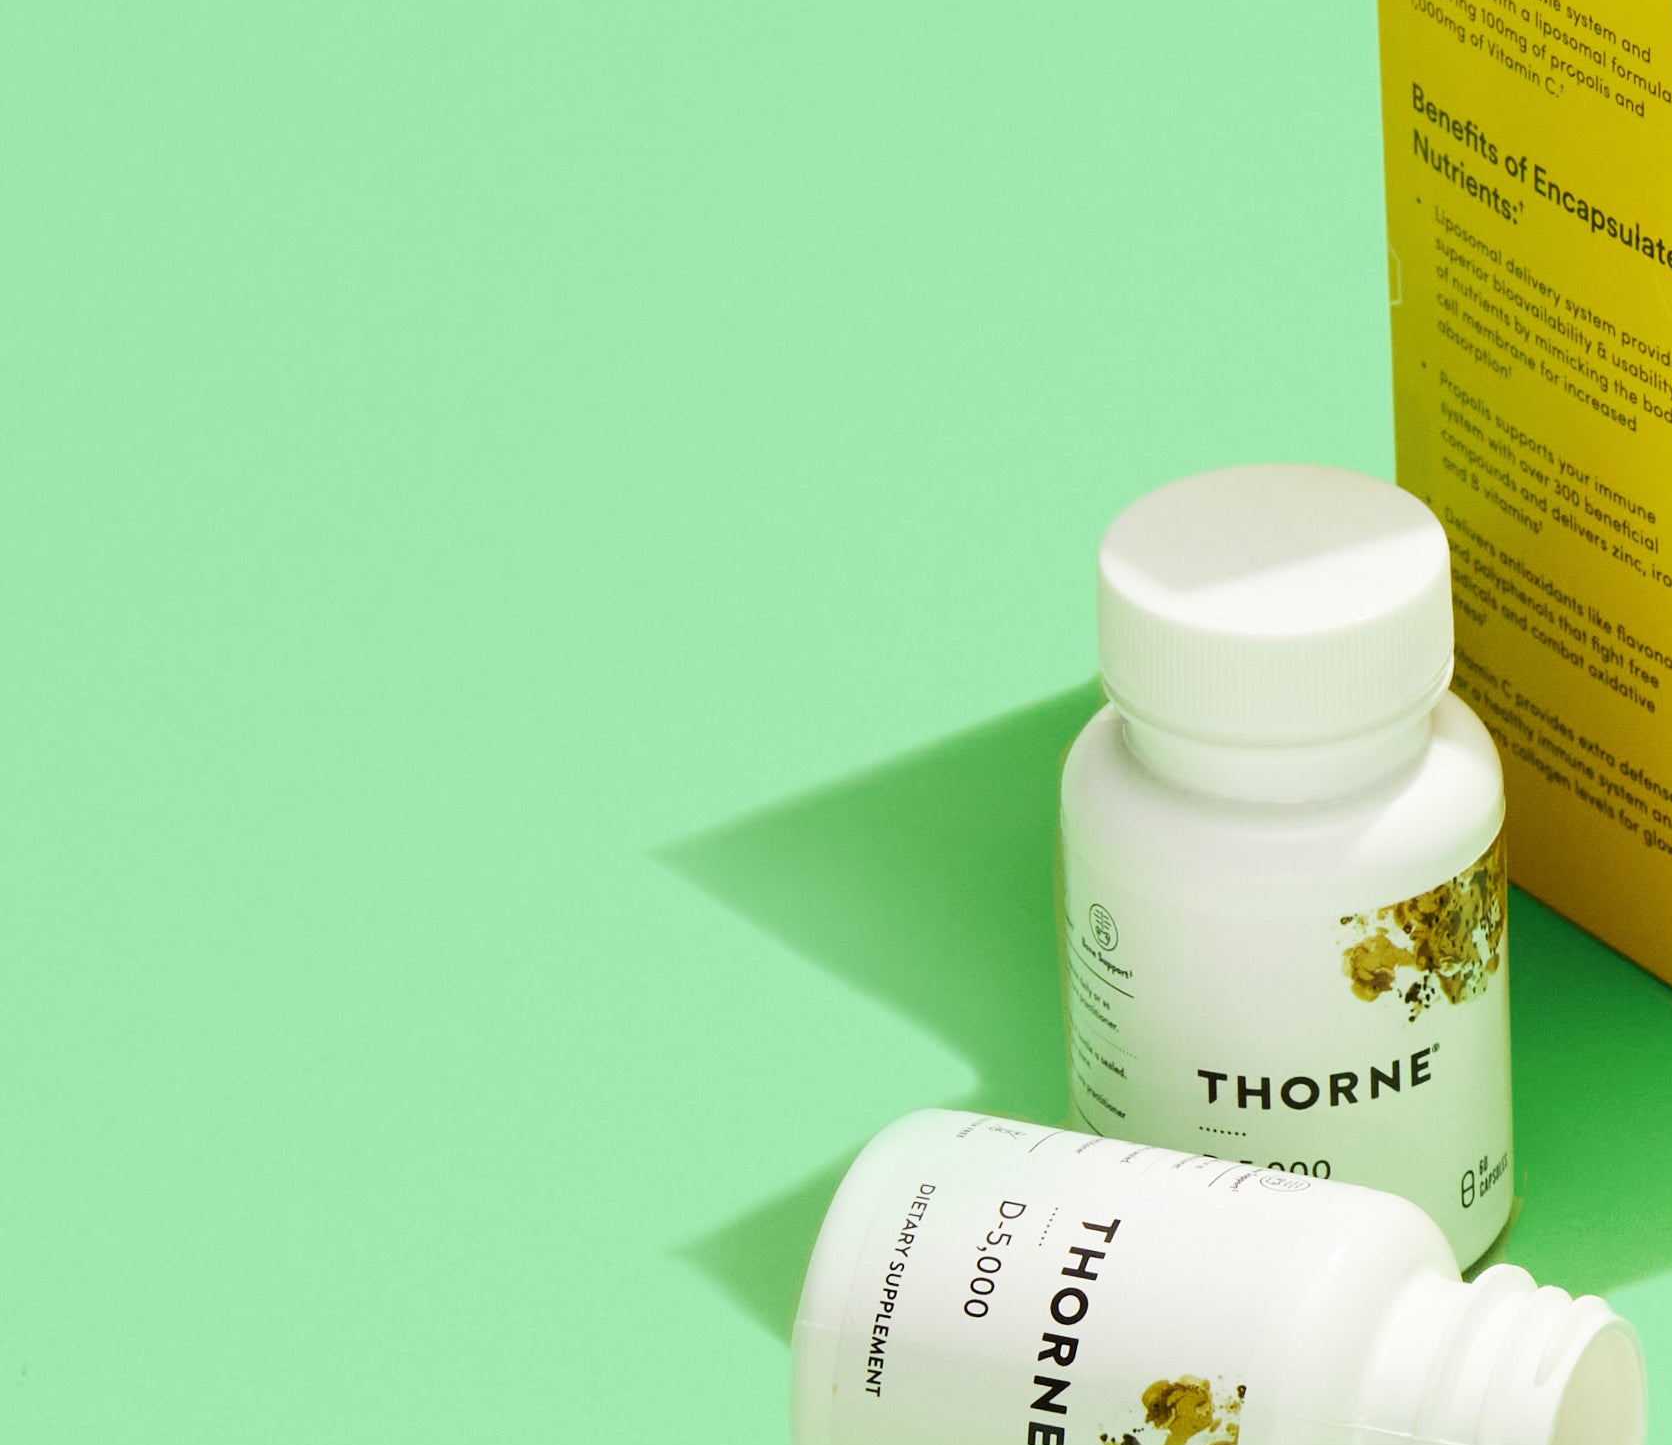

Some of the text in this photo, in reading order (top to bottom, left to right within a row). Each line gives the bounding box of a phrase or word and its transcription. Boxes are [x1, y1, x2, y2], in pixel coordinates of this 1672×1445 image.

[1470, 30, 1540, 86] of Vitamin
[1481, 8, 1527, 53] 100mg
[1532, 43, 1546, 59] of
[1615, 90, 1644, 118] and
[1521, 8, 1530, 22] a
[1535, 11, 1606, 66] liposomal
[1611, 58, 1672, 104] formula
[1566, 3, 1616, 44] system
[1621, 37, 1651, 63] and
[1412, 82, 1498, 165] Benefits
[1504, 154, 1527, 183] of
[1435, 208, 1502, 266] Liposomal
[1506, 258, 1561, 308] delivery
[1565, 297, 1616, 337] system
[1435, 237, 1489, 282] superior
[1597, 342, 1607, 359] &
[1436, 265, 1638, 406] of by mimicking the
[1540, 360, 1637, 432] for increased
[1495, 415, 1656, 525] supports your immune
[1520, 460, 1659, 554] over 300 beneficial
[1521, 483, 1608, 553] and delivers
[1588, 606, 1612, 635] like
[1630, 658, 1660, 689] free
[865, 1183, 936, 1397] DIETARY SUPPLEMENT
[964, 1200, 1027, 1318] D-5,000
